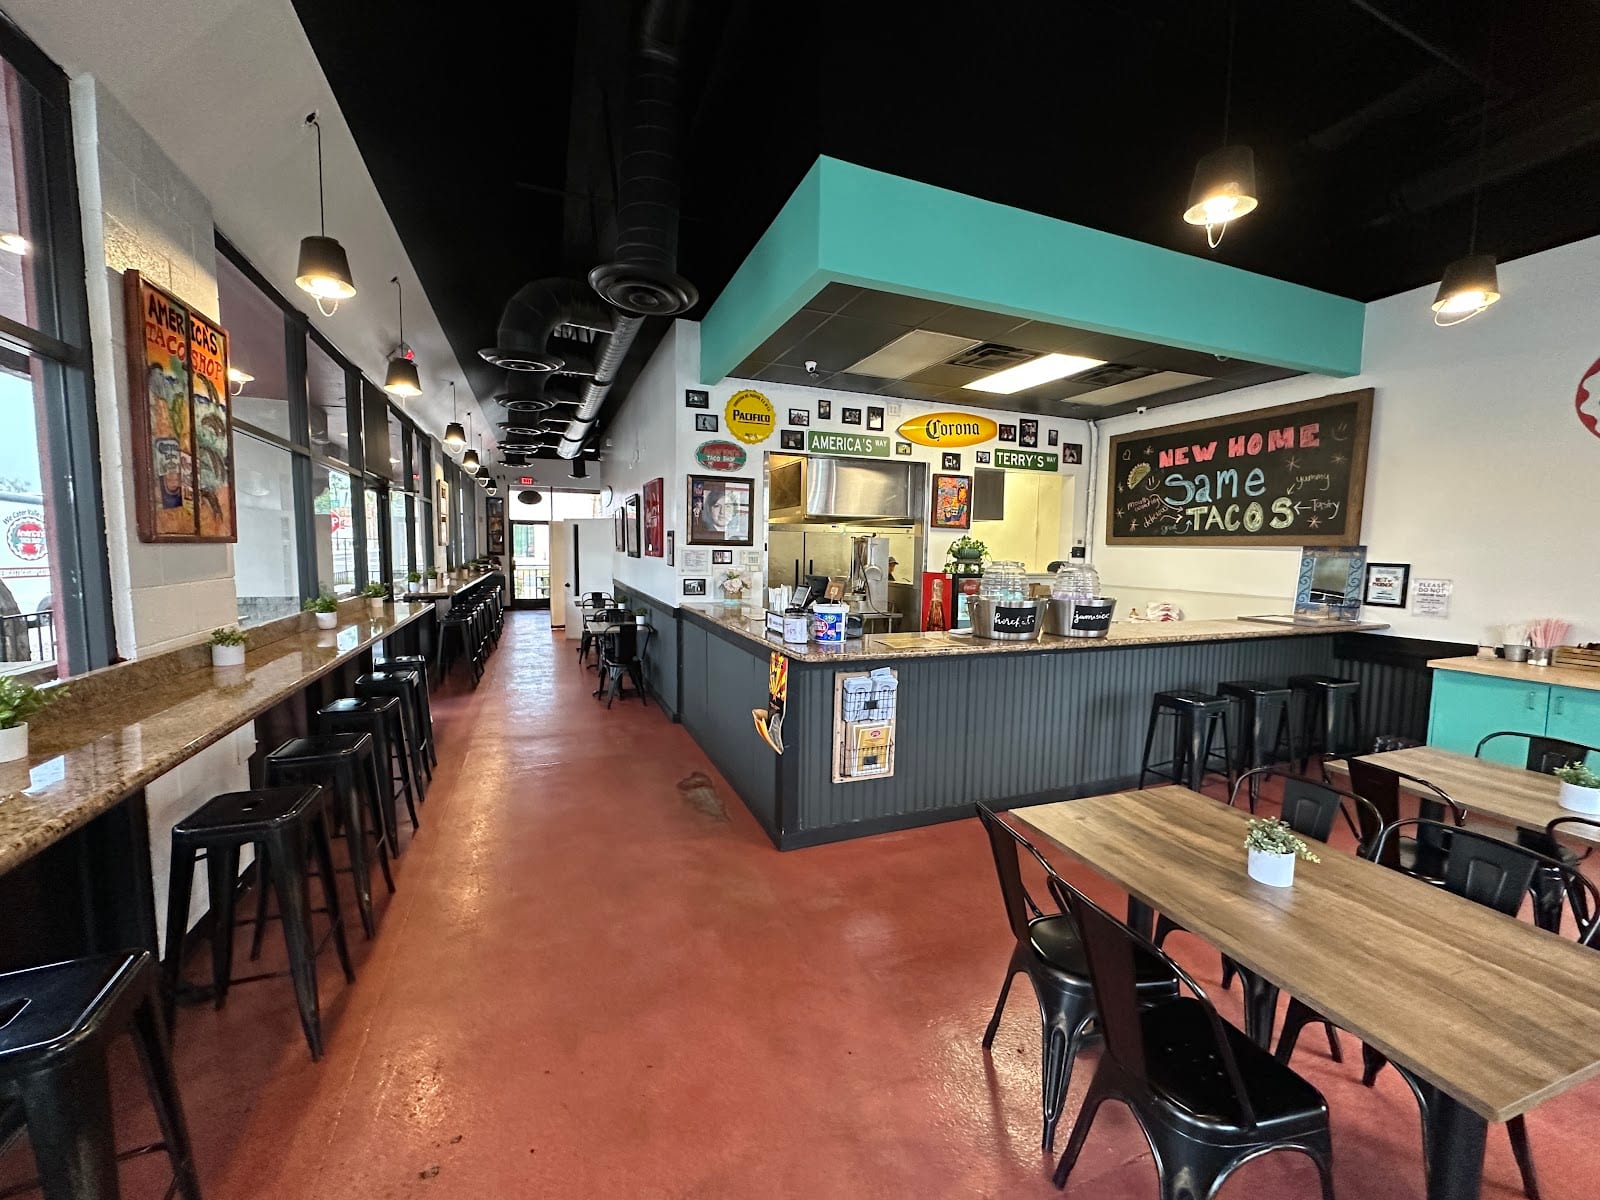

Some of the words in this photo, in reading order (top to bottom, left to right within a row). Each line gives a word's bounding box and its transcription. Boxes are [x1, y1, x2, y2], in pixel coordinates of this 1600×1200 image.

[146, 321, 186, 361] TACO
[192, 349, 223, 380] SHOP
[811, 434, 873, 453] AMERICA'S
[874, 439, 888, 448] WAY
[925, 419, 980, 442] Corona
[996, 451, 1045, 468] TERRY'S
[1158, 441, 1218, 469] NEW
[1228, 423, 1320, 458] HOME
[1164, 467, 1266, 506] Same
[1295, 473, 1330, 491] yummy
[1186, 496, 1294, 533] TACOS
